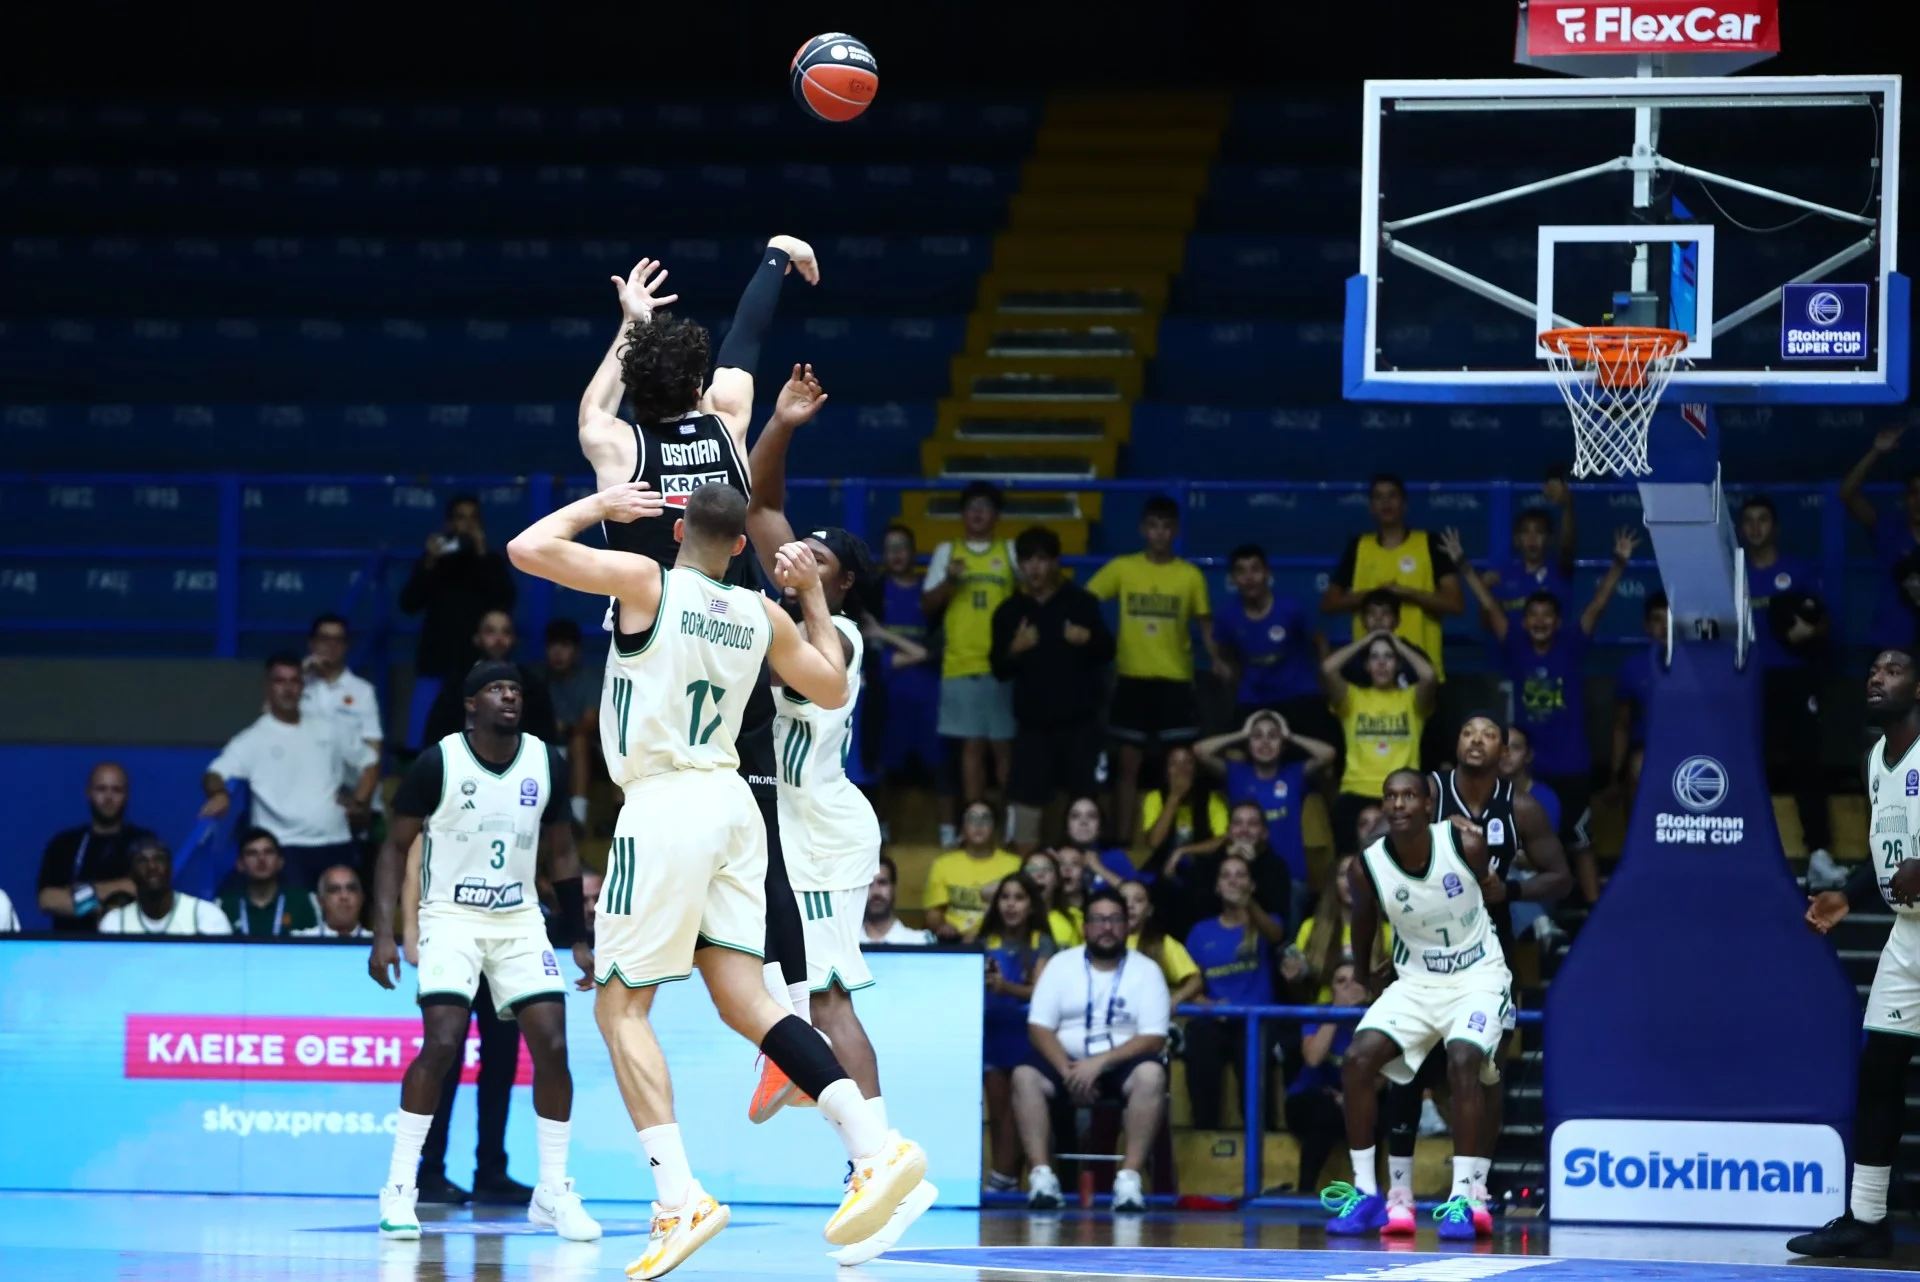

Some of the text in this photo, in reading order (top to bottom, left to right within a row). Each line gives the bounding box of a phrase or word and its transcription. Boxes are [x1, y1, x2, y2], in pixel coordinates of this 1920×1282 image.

[1596, 7, 1761, 42] FlexCar
[1788, 329, 1861, 342] Stoiximan
[1788, 342, 1861, 354] SUPER CUP
[661, 439, 721, 466] OSMAN
[1656, 812, 1744, 830] Stoiximan
[1656, 828, 1744, 844] SUPER CUP
[490, 839, 506, 869] 3
[1882, 839, 1903, 869] 26
[1435, 927, 1450, 948] 7
[147, 1032, 285, 1067] ΚΛΕΙΣΕ
[295, 1034, 401, 1068] ΘΕΣΗ
[203, 1103, 399, 1138] skyexpress.c
[1564, 1146, 1824, 1195] Stoiximan
